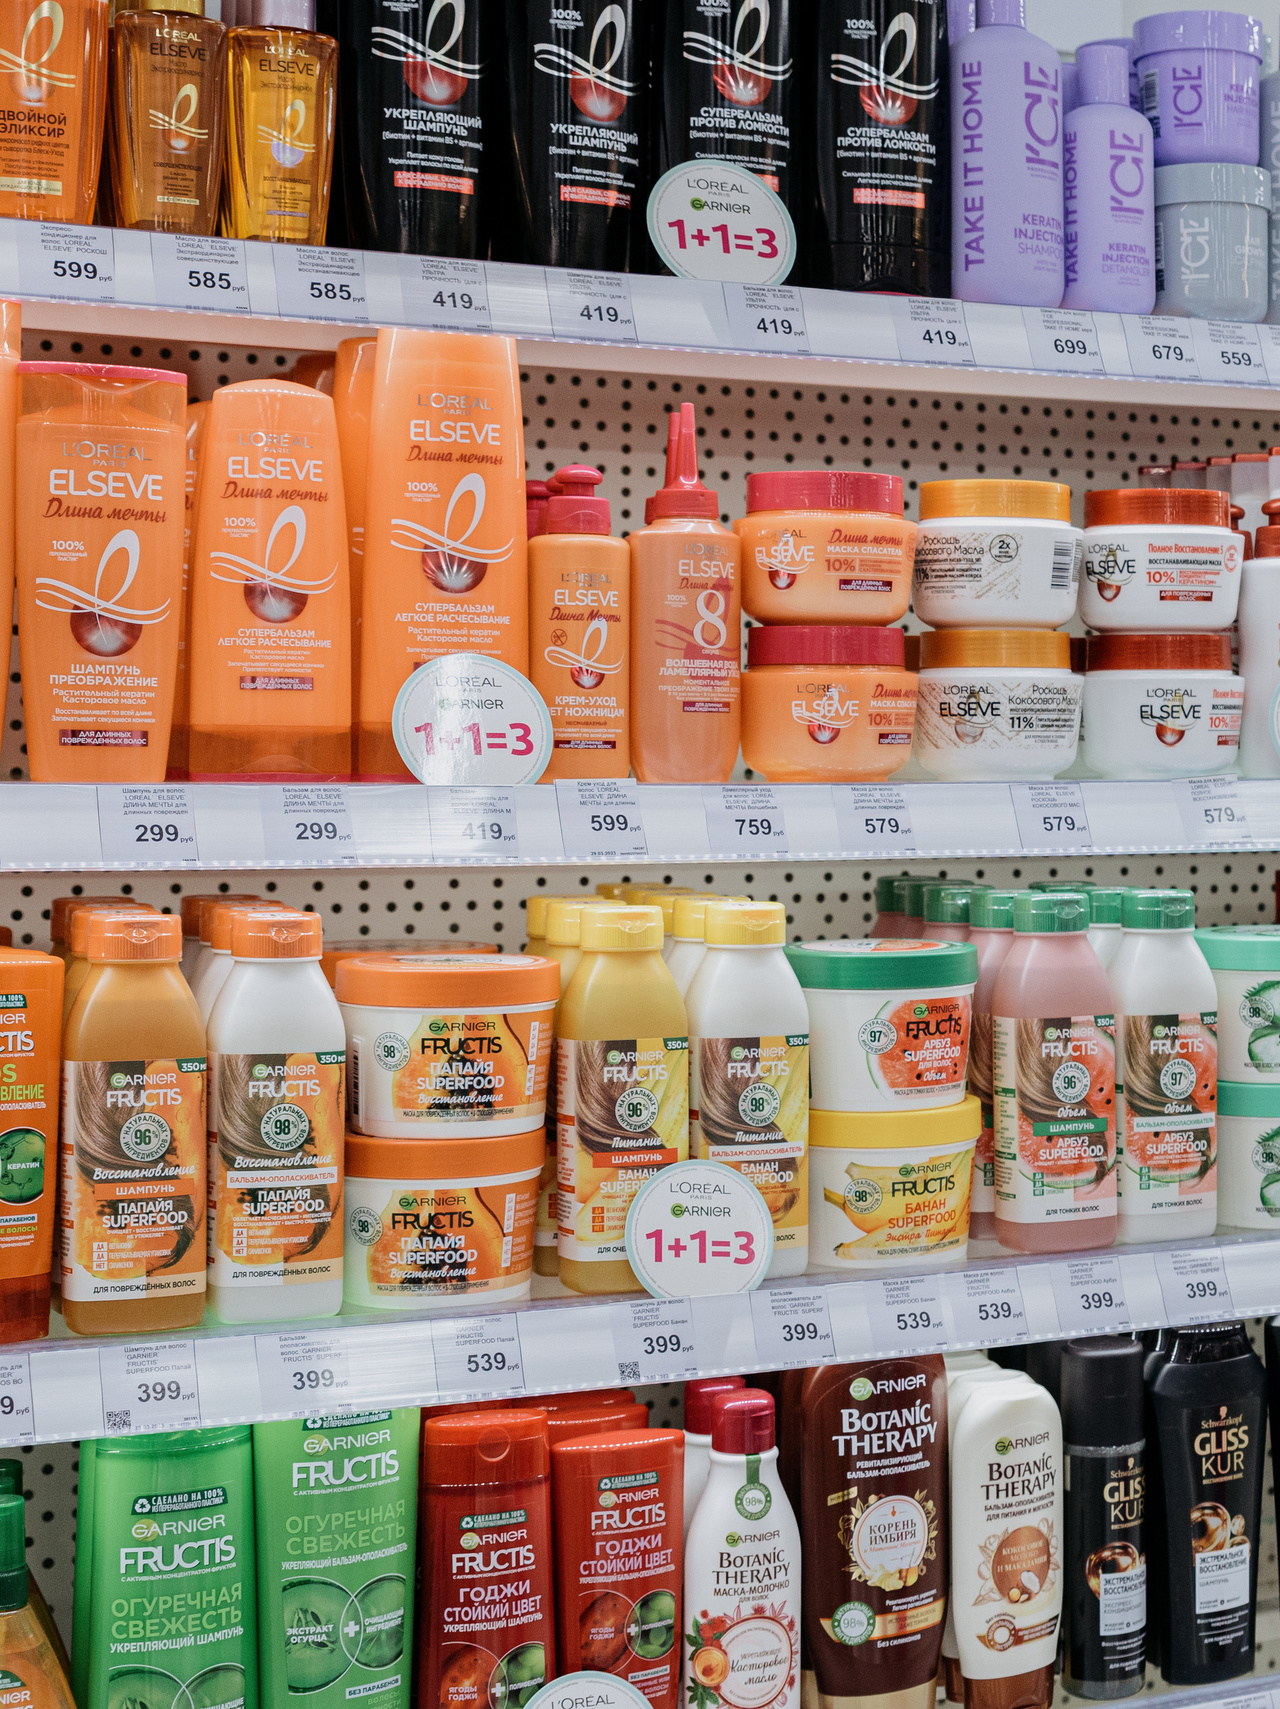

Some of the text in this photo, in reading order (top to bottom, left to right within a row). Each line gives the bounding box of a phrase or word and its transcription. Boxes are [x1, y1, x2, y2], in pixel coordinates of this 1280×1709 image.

[259, 59, 314, 77] ELSEVE
[384, 108, 483, 129] УКРЕПЛЯЮЩИЙ
[700, 107, 784, 125] СУПЕРБАЛЬЗАМ
[403, 120, 468, 137] ШАМПУНЬ
[690, 117, 790, 136] ПРОТИВ ЛОМКОСТИ
[962, 60, 985, 271] TAKE IT HOME
[686, 178, 750, 195] L'ORÉAL
[708, 190, 731, 198] PARIS
[690, 197, 751, 216] GARNIER
[668, 219, 780, 259] 1+1=3
[1109, 242, 1147, 254] KERATIN
[1102, 253, 1150, 266] INJECTION
[52, 261, 98, 280] 599
[188, 270, 232, 290] 585
[432, 291, 473, 309] 419
[580, 305, 619, 323] 419
[757, 318, 793, 336] 419
[1054, 339, 1087, 354] 699
[1152, 345, 1184, 361] 679
[1221, 351, 1252, 366] 559
[410, 420, 501, 445] ELSEVE
[63, 441, 152, 462] L'ORÉAL
[93, 459, 126, 467] PARIS
[228, 457, 323, 482] ELSEVE
[50, 470, 162, 500] ELSEVE
[221, 481, 328, 502] Длина мечты
[42, 497, 167, 523] Длина мечты
[52, 541, 84, 551] 100%
[827, 546, 902, 556] МАСКА СПАСАТЕЛЬ
[1148, 543, 1173, 554] Полное
[1174, 544, 1219, 555] Восстановление
[825, 558, 856, 572] 10%
[238, 628, 316, 638] СУПЕРБАЛЬЗАМ
[218, 638, 332, 648] ЛЕГКОЕ РАСЧЕСЫВАНИЕ
[71, 663, 141, 676] ШАМПУНЬ
[49, 674, 158, 687] ПРЕОБРАЖЕНИЕ
[52, 688, 155, 698] Растительный кератин
[62, 696, 118, 705] Касторовое
[555, 696, 617, 708] КРЕМ-УХОД
[939, 702, 1001, 717] ELSEVE
[414, 722, 535, 757] 1+1=3
[295, 822, 338, 841] 299
[590, 814, 629, 832] 599
[734, 818, 772, 836] 759
[864, 818, 900, 834] 579
[135, 824, 194, 844] 299 руб
[421, 1037, 502, 1055] FRUCTIS
[106, 1088, 182, 1108] FRUCTIS
[1050, 1122, 1094, 1133] ШАМПУНЬ
[611, 1135, 663, 1149] Питание
[1057, 1137, 1089, 1148] АРБУЗ
[93, 1163, 196, 1181] Восстановление
[229, 1171, 336, 1184] БАЛЬЗАМ-ОПОЛАСКИВАТЕЛЬ
[116, 1184, 175, 1196] ШАМПУНЬ
[891, 1175, 956, 1198] FRUCTIS
[118, 1199, 173, 1215] ПАПАЙЯ
[905, 1198, 947, 1215] БАНАН
[102, 1210, 188, 1228] SUPERFOOD
[888, 1209, 957, 1229] SUPERFOOD
[645, 1228, 756, 1265] 1+1=3
[93, 1279, 196, 1294] ДЛЯ ПОВРЕЖДЁННЫХ ВОЛОС
[1080, 1292, 1114, 1310] 399
[782, 1323, 818, 1342] 399
[467, 1352, 520, 1373] 539 руб
[137, 1380, 196, 1403] 399 руб
[849, 1373, 927, 1401] GARNIER
[832, 1421, 938, 1457] THERAPY
[1194, 1425, 1249, 1455] GLISS
[1202, 1451, 1245, 1477] KUR
[132, 1513, 226, 1542] GARNIER
[869, 1519, 917, 1535] КОРЕНЬ
[869, 1530, 918, 1546] ИМБИРЯ
[119, 1534, 236, 1575] FRUCTIS
[111, 1581, 242, 1619] ОГУРЕЧНАЯ
[459, 1579, 531, 1603] ГОДЖИ
[443, 1595, 542, 1623] СТОЙКИЙ ЦВЕТ
[111, 1608, 242, 1641] СВЕЖЕСТЬ
[286, 1624, 334, 1636] ЭКСТРАКТ
[109, 1625, 244, 1654] УКРЕПЛЯЮЩИЙ ШАМПУНЬ
